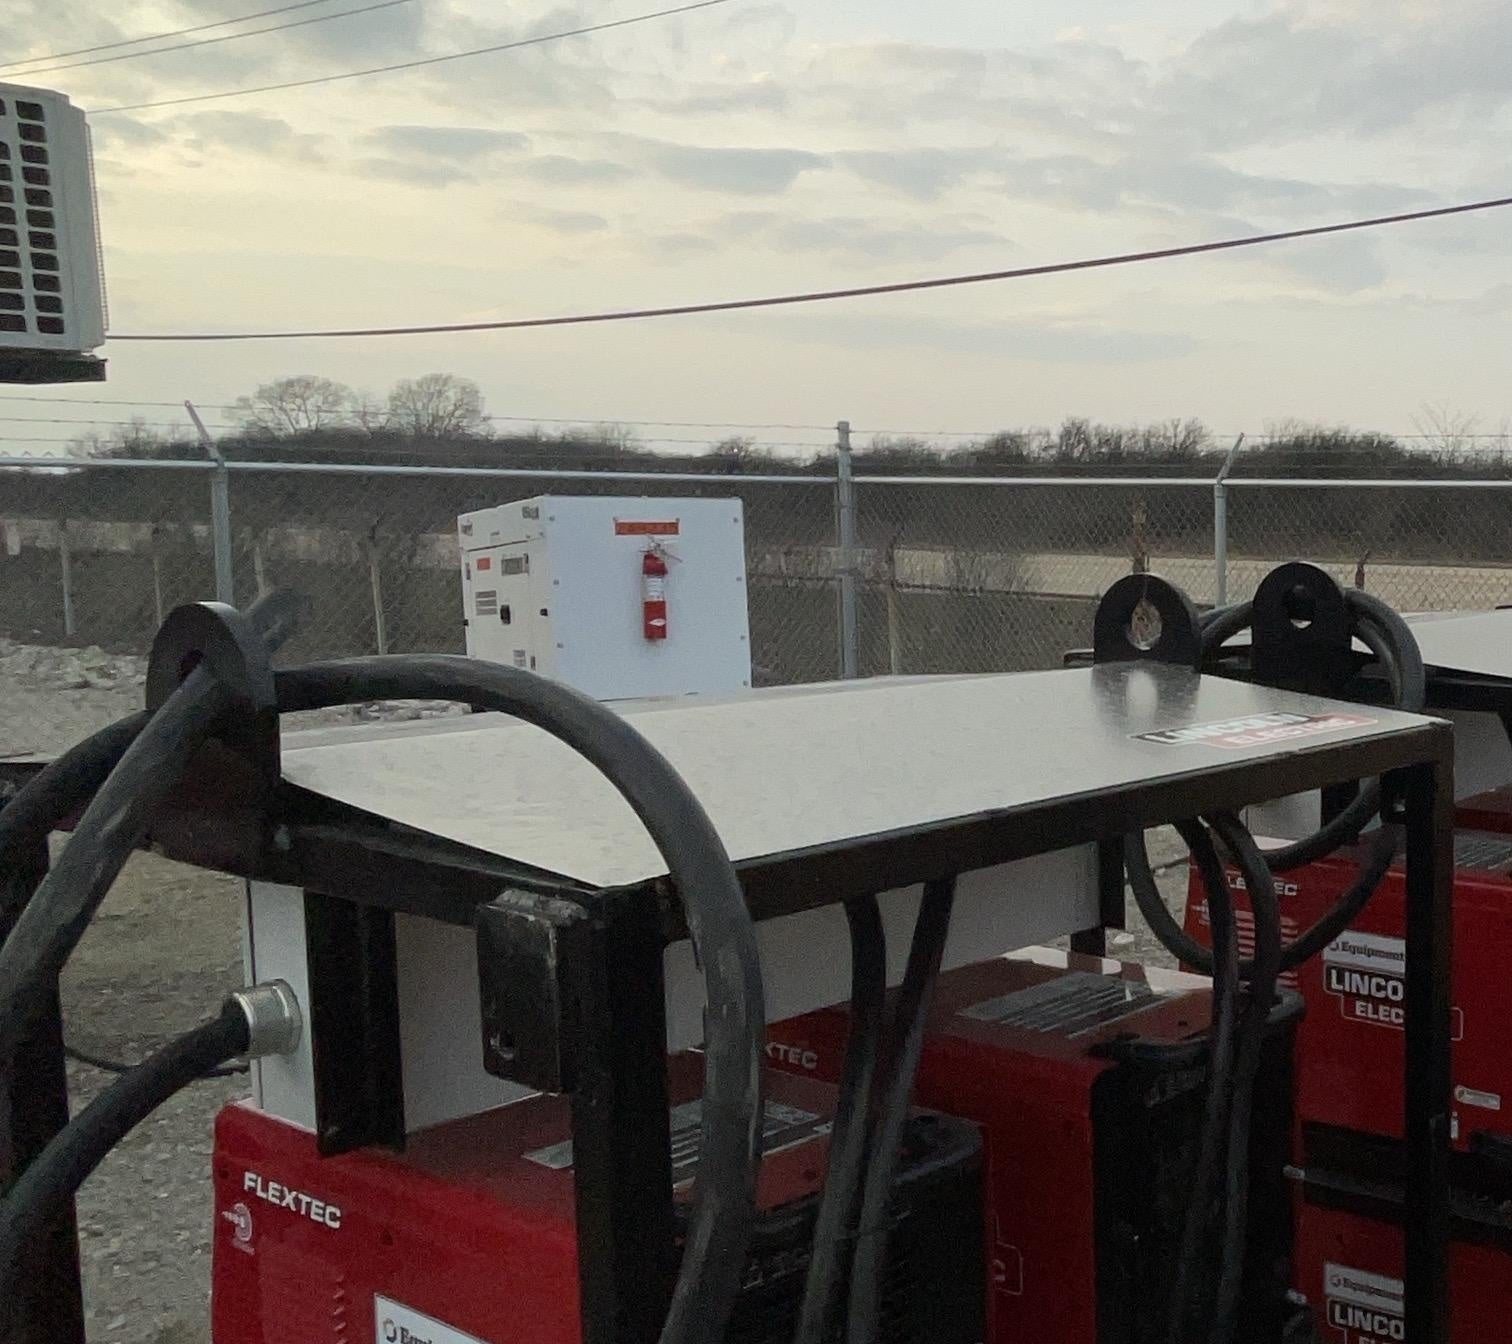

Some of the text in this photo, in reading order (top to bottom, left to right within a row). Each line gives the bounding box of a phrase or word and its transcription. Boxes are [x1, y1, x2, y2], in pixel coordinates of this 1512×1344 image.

[1331, 969, 1404, 1002] LINCO
[1355, 1000, 1404, 1024] ELEC
[243, 1171, 341, 1230] FLEXTEC
[1334, 1304, 1404, 1341] LINCO
